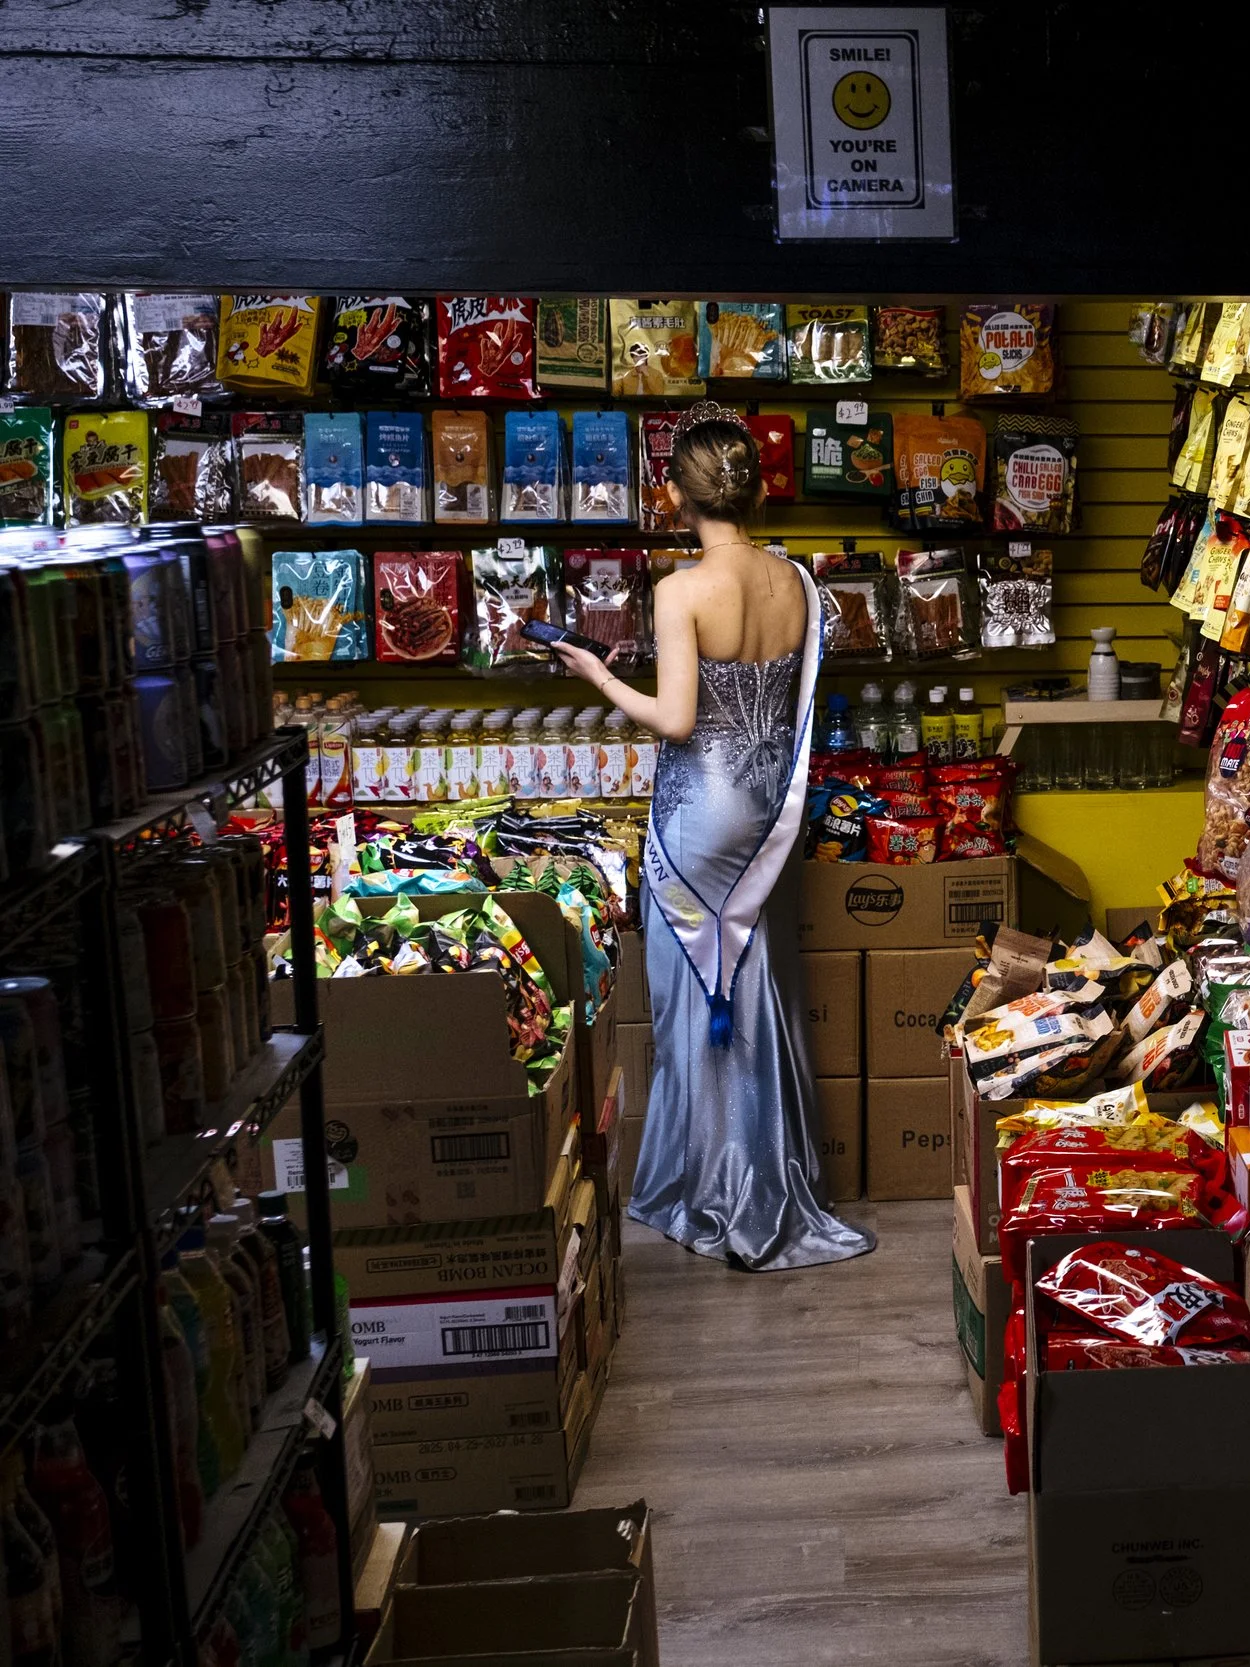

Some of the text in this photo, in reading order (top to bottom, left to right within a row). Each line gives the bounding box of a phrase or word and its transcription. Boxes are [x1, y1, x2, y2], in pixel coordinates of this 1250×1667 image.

[829, 48, 891, 62] SMILE!
[829, 140, 897, 153] YOU'RE
[850, 160, 877, 173] ON
[827, 180, 904, 193] CAMERA
[798, 309, 854, 320] TOAST
[811, 437, 843, 466] 脆
[914, 466, 928, 477] EGG
[1013, 461, 1038, 474] CHILLI
[920, 478, 937, 489] FISH
[1012, 474, 1061, 492] CRAB EGG
[1220, 757, 1240, 769] MATE
[889, 834, 919, 852] 薯条
[847, 890, 878, 910] Lay's
[438, 1265, 487, 1283] BOMB
[492, 1261, 547, 1279] OCEAN
[353, 1335, 406, 1349] Yogurt Flavor
[1111, 1538, 1205, 1553] CHUNWEI INC.
